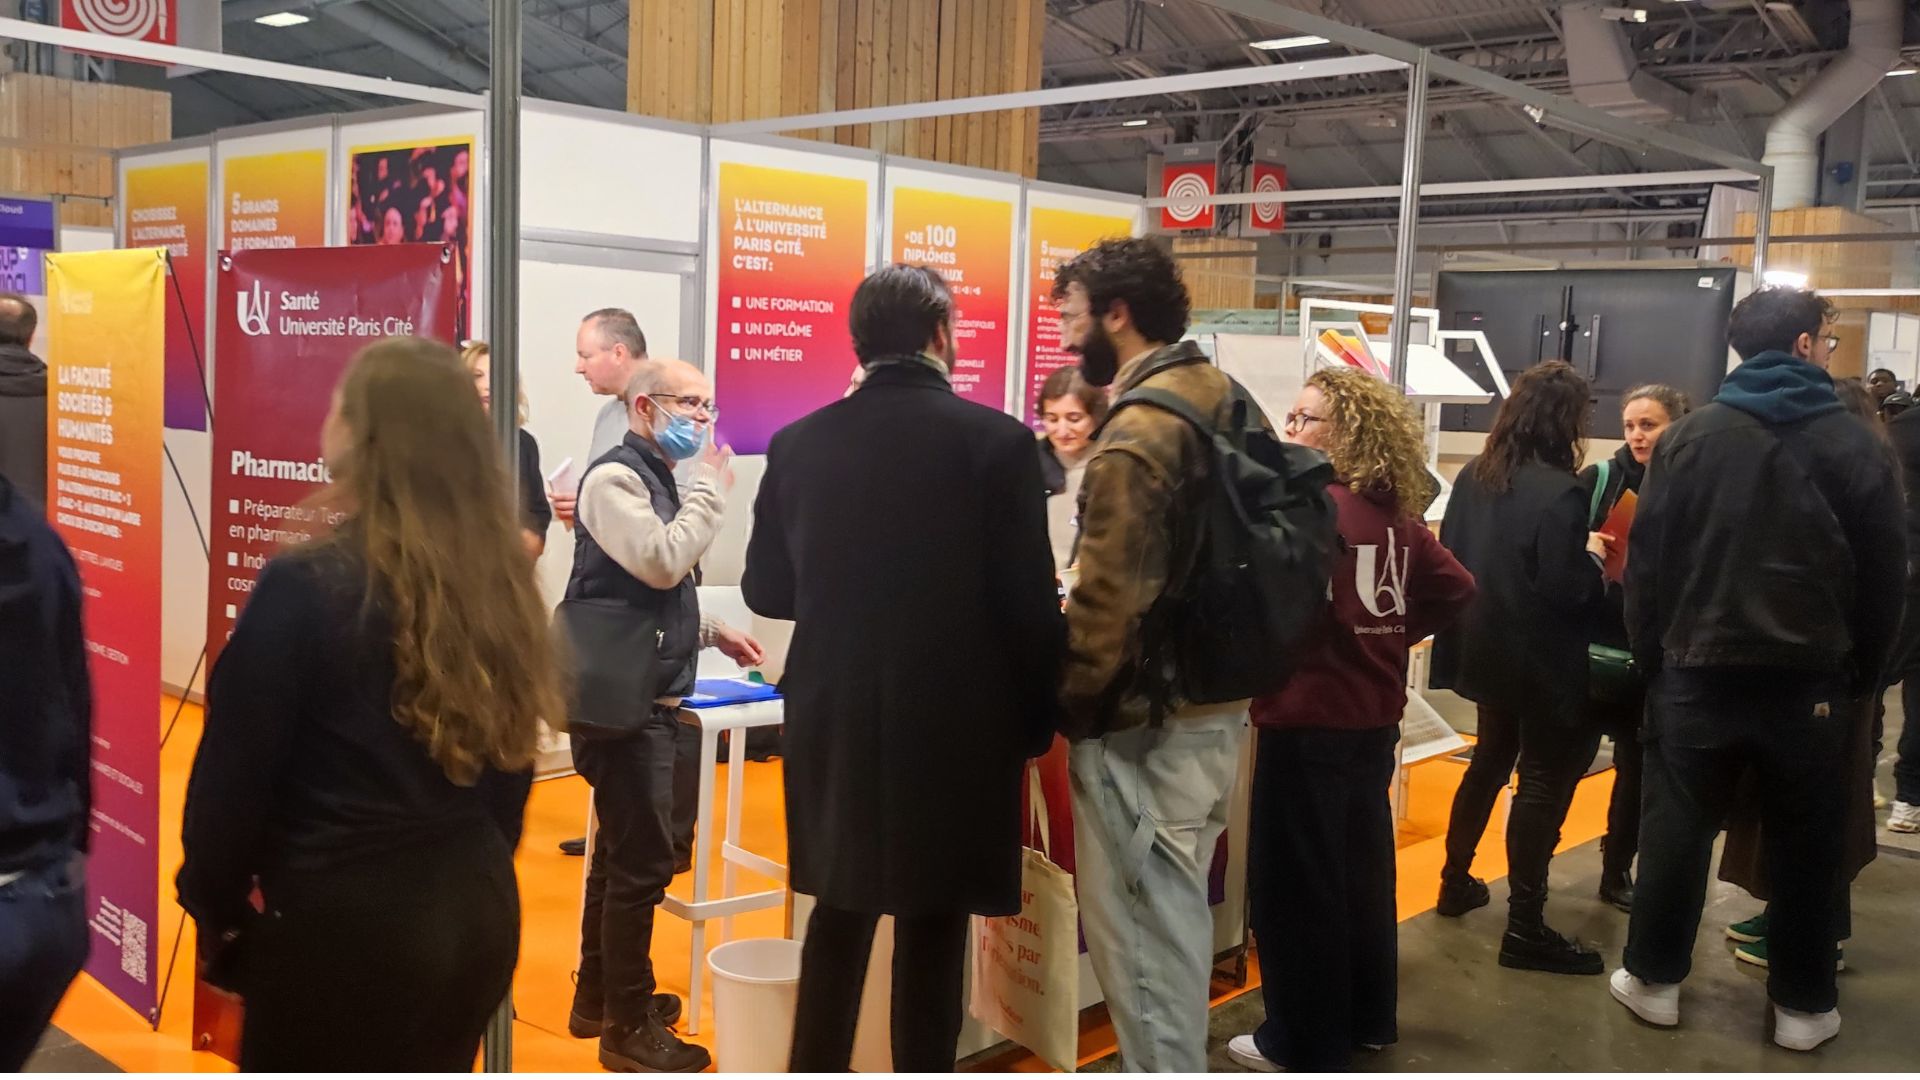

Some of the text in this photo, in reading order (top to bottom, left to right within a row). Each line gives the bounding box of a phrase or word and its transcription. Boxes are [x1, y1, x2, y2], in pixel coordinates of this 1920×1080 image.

[232, 191, 279, 215] 5 GRANDS
[735, 199, 824, 221] L'ALTERNANCE
[231, 216, 277, 233] DOMAINES
[734, 214, 827, 239] À L'UNIVERSITÉ
[245, 235, 296, 249] FORMATION
[734, 236, 804, 257] PARIS CITÉ,
[925, 225, 956, 248] 100
[904, 246, 956, 265] DIPLÔMES
[280, 290, 319, 311] Santé
[746, 297, 833, 313] UNE FORMATION
[279, 316, 414, 336] Université Paris Cité
[745, 321, 812, 338] UN DIPLÔME
[745, 345, 803, 361] UN MÉTIER
[70, 361, 112, 389] FACULTÉ
[231, 450, 333, 483] Pharmacie
[244, 499, 315, 523] Préparateur
[229, 525, 311, 544] en pharmacie
[1017, 944, 1041, 964] par
